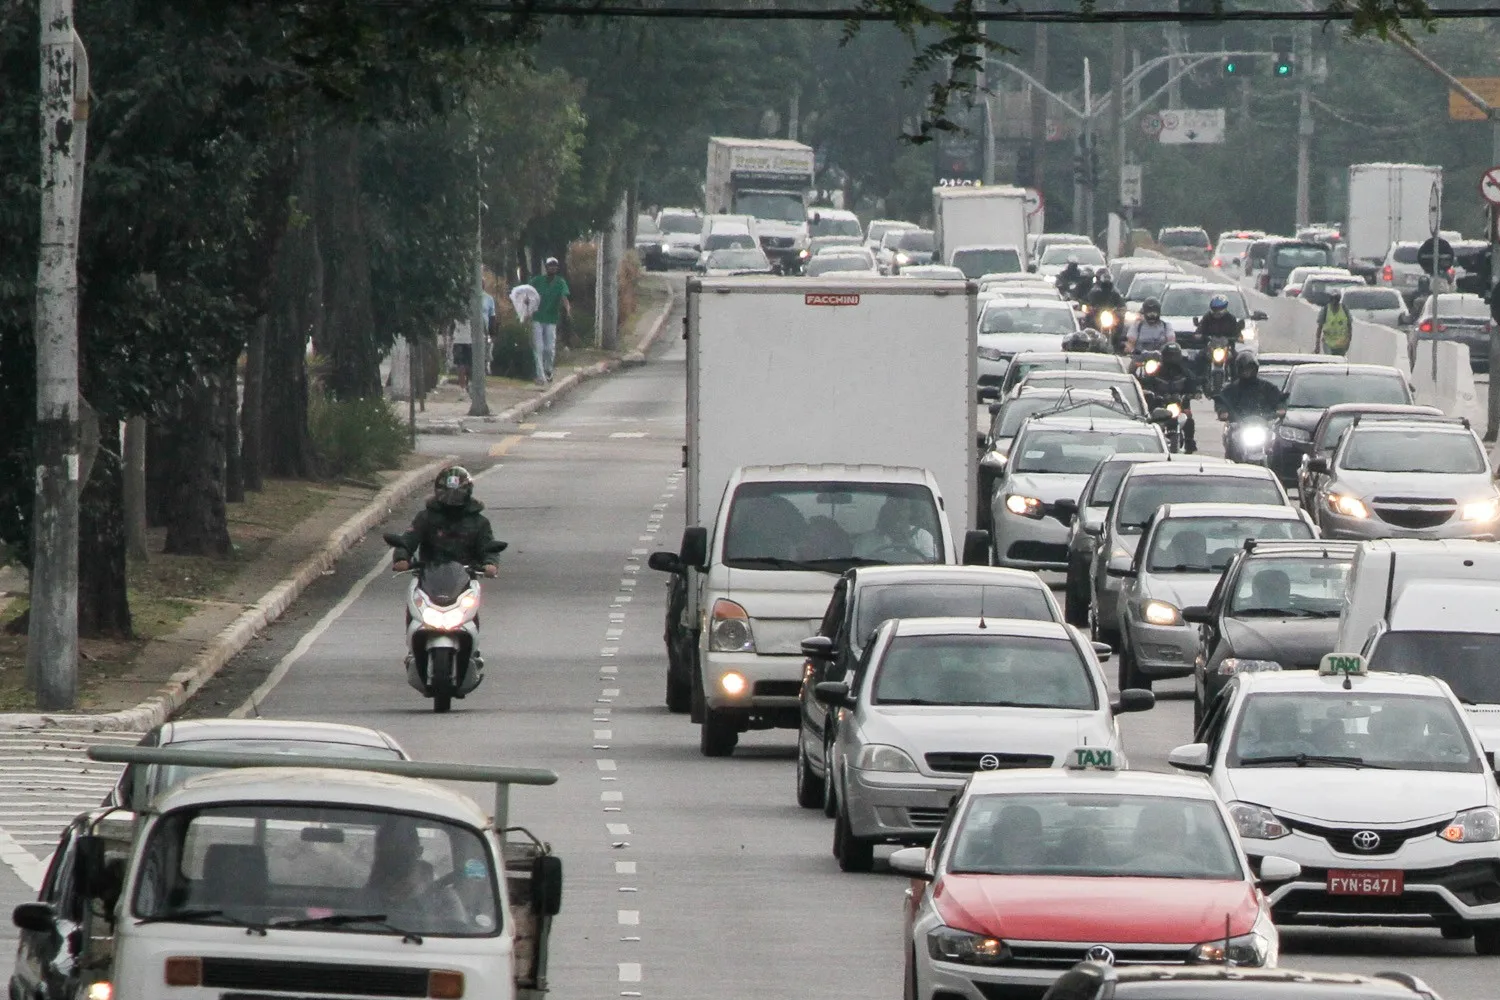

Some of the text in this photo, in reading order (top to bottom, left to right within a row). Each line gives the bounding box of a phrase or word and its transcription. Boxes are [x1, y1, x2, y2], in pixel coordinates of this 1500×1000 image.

[806, 295, 859, 304] FACCHINI
[1328, 656, 1360, 672] TAXI
[1073, 749, 1112, 767] TAXI
